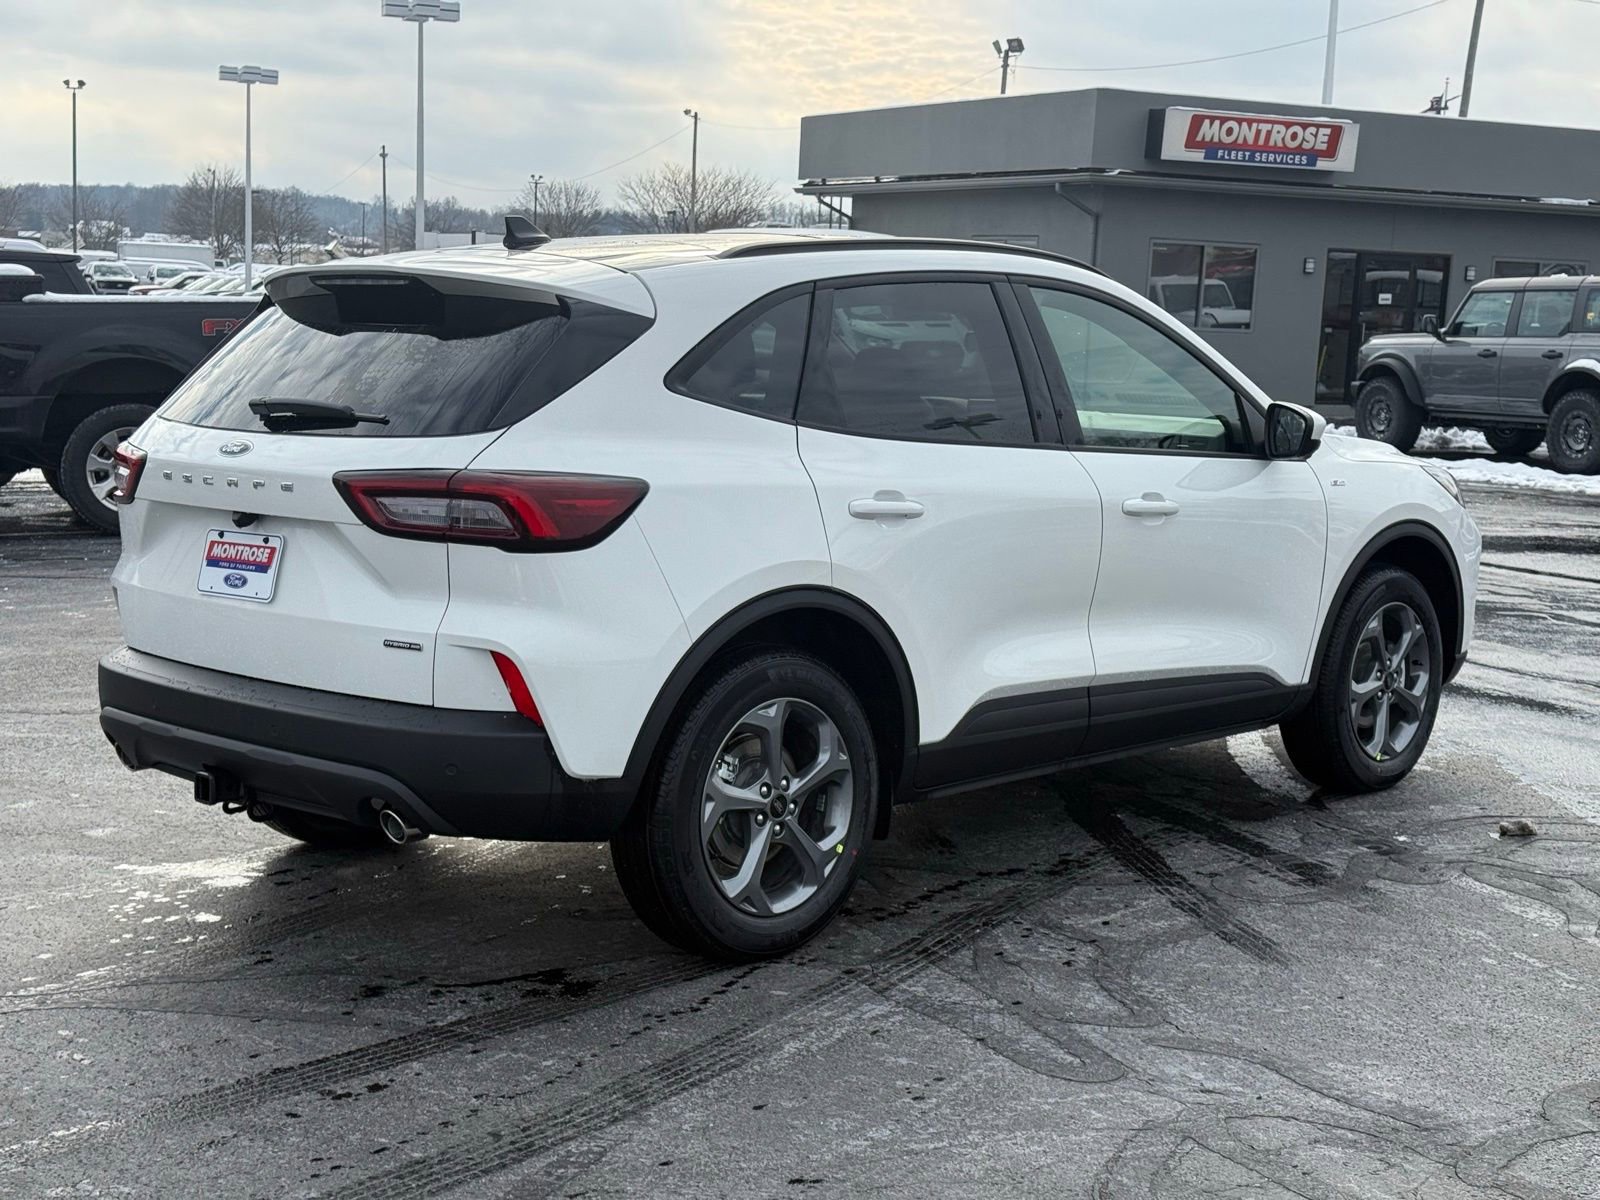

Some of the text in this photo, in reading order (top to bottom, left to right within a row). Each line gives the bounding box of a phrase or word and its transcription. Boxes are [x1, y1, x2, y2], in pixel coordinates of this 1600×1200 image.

[1196, 119, 1331, 150] MONTROSE
[1217, 150, 1308, 164] FLEET SERVICES
[162, 470, 294, 492] ESCAPE
[210, 543, 271, 562] MONTROSE
